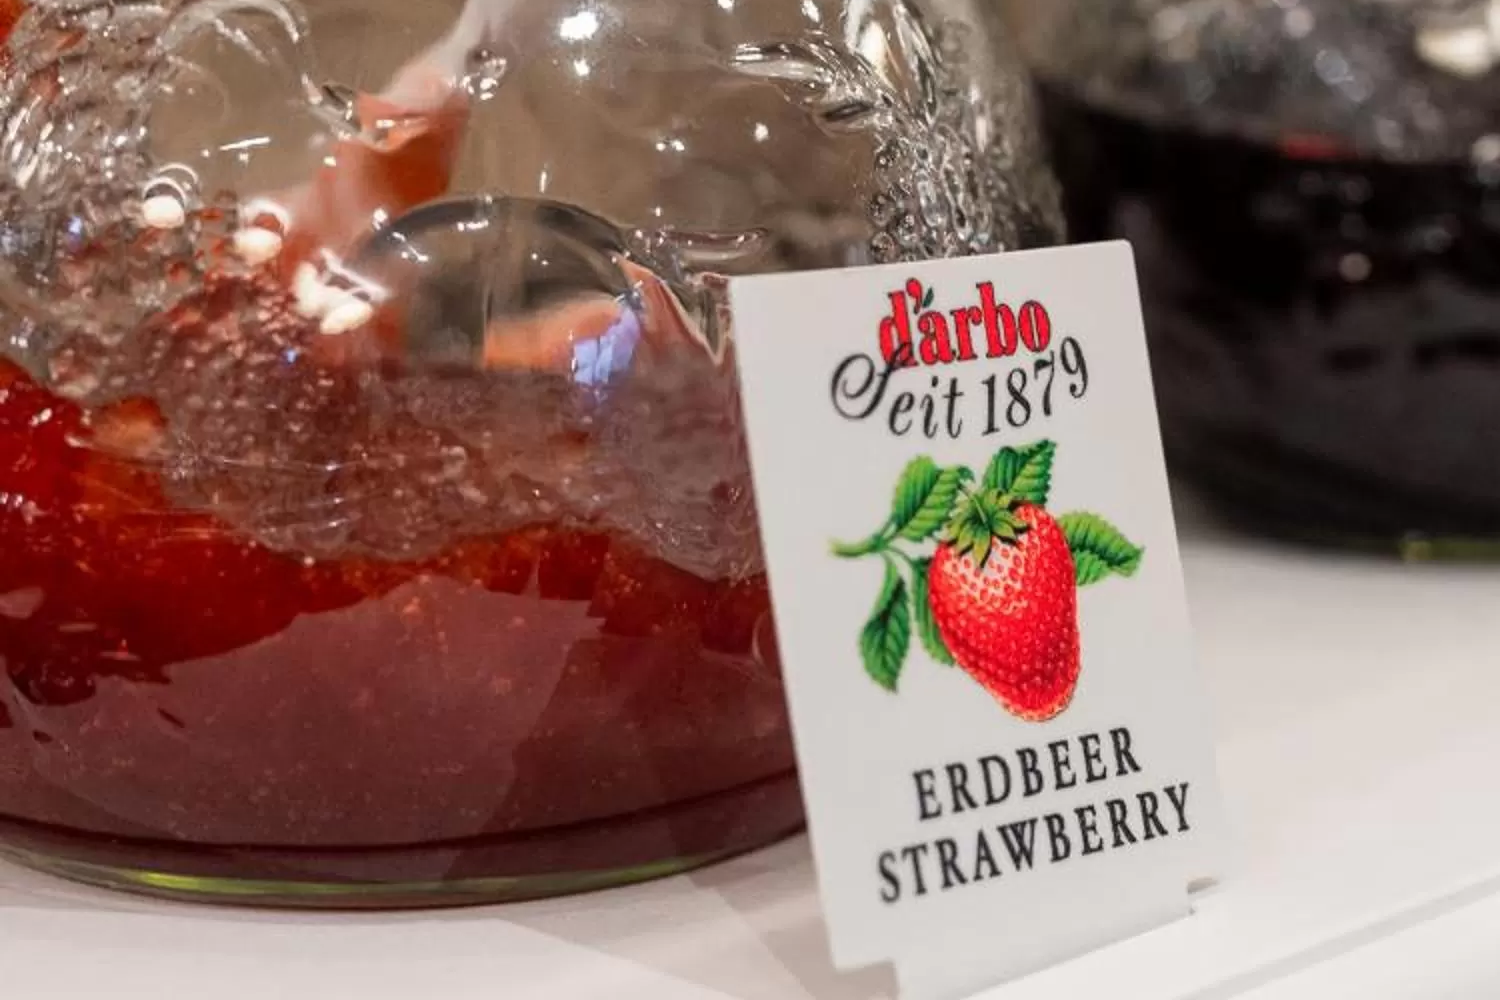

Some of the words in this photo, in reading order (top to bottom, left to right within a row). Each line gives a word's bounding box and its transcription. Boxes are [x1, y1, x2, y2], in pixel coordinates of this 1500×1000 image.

[831, 341, 964, 440] Seit
[981, 336, 1089, 437] 1879
[912, 727, 1142, 822] ERDBEER
[877, 781, 1191, 905] STRAWBERRY
